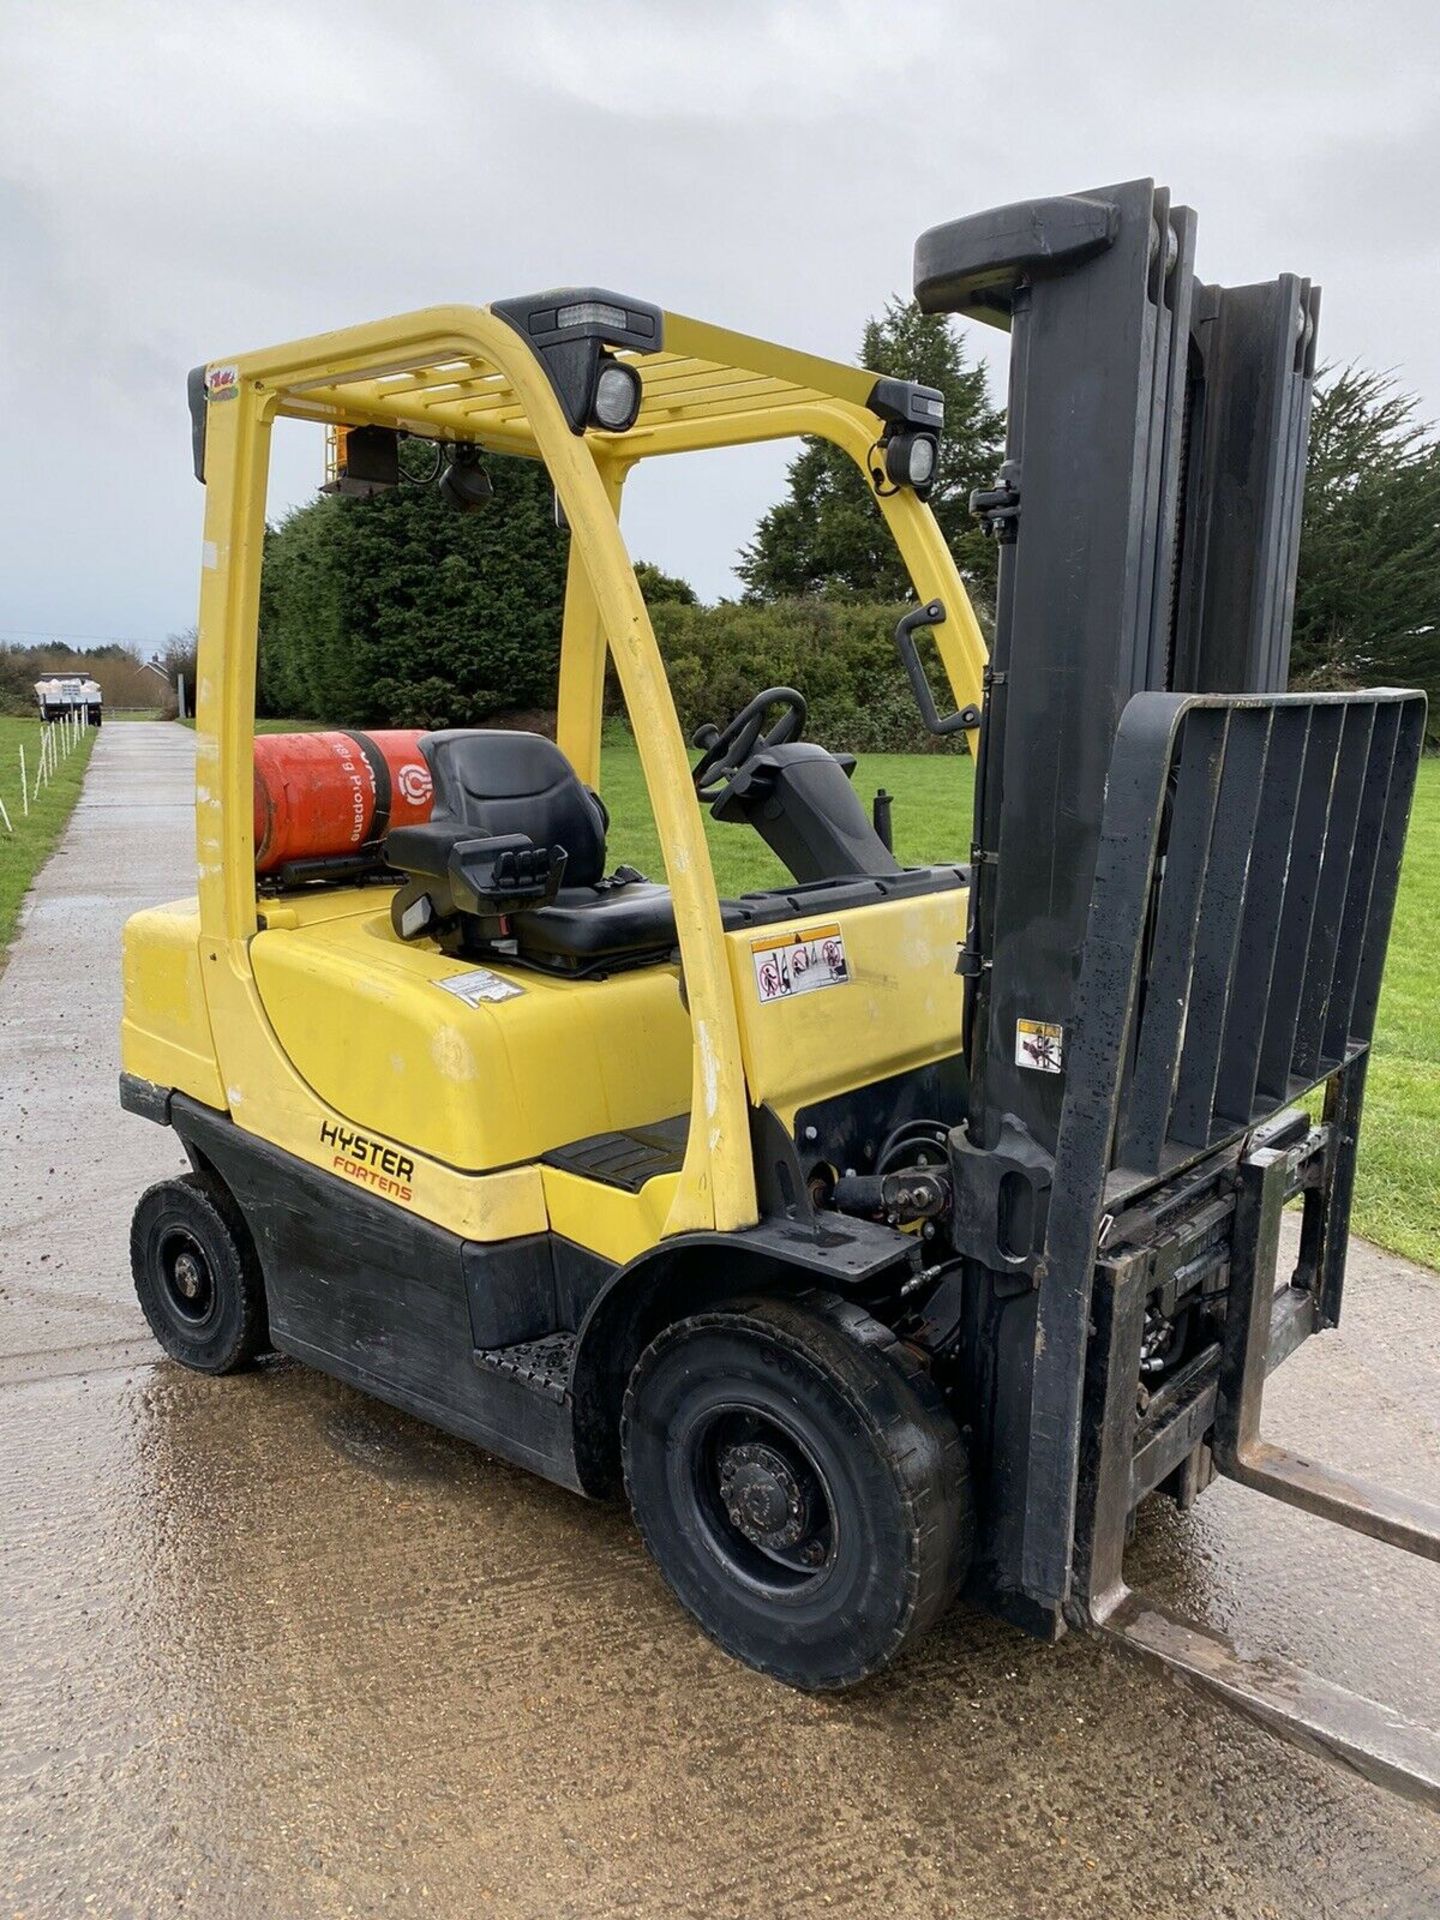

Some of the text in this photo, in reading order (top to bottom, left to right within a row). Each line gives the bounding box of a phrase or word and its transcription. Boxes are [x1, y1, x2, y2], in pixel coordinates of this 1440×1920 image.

[350, 775, 364, 842] Propane
[320, 1120, 414, 1183] HYSTER
[333, 1155, 412, 1202] FORTENS
